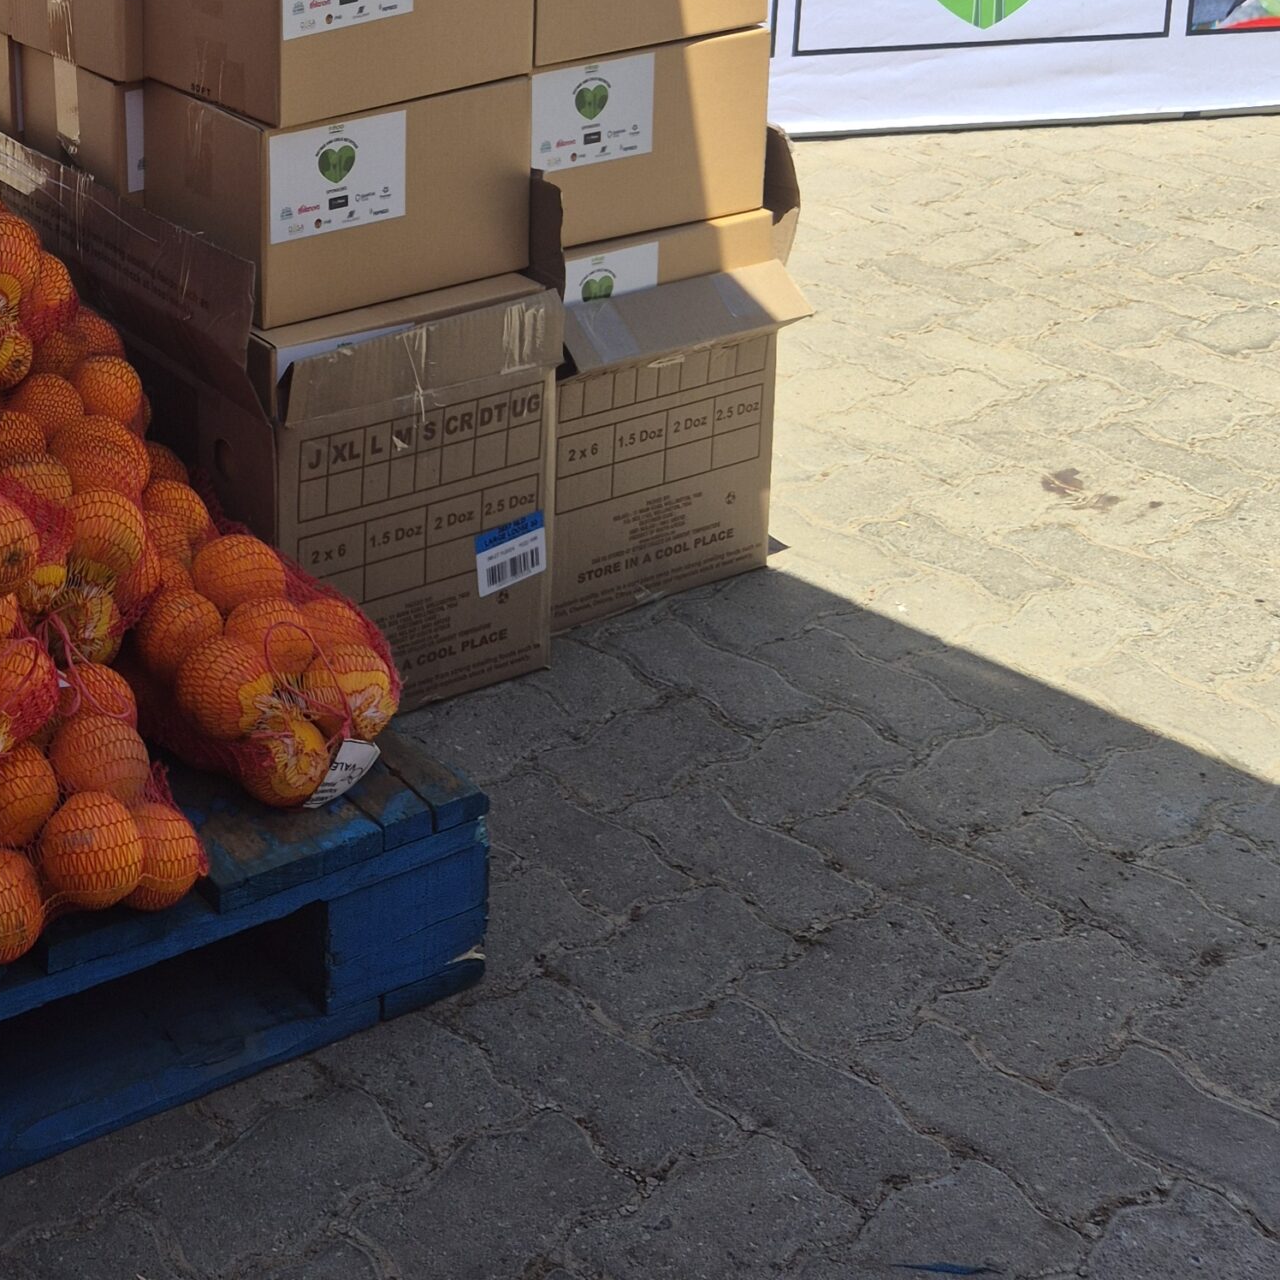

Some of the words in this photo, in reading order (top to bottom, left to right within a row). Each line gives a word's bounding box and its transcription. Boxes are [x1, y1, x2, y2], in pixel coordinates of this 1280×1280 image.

[331, 439, 361, 466] XL
[370, 435, 384, 455] L
[423, 421, 437, 441] S
[444, 410, 475, 436] CR
[479, 401, 509, 428] DT
[568, 448, 576, 461] 2
[591, 442, 599, 456] 6
[639, 425, 664, 443] Doz
[673, 420, 681, 433] 2
[683, 413, 708, 429] Doz
[716, 406, 735, 422] 2.5
[737, 400, 760, 415] Doz
[311, 549, 321, 564] 2
[337, 543, 347, 558] 6
[395, 524, 423, 541] Doz
[434, 517, 443, 530] 2
[447, 510, 475, 527] Doz
[484, 500, 504, 516] 2.5
[508, 493, 535, 509] Doz
[577, 562, 621, 584] STORE
[625, 557, 639, 570] IN
[642, 553, 652, 564] A
[655, 544, 690, 560] COOL
[694, 528, 734, 549] PLACE
[402, 659, 413, 671] A
[416, 645, 456, 666] COOL
[461, 628, 508, 652] PLACE
